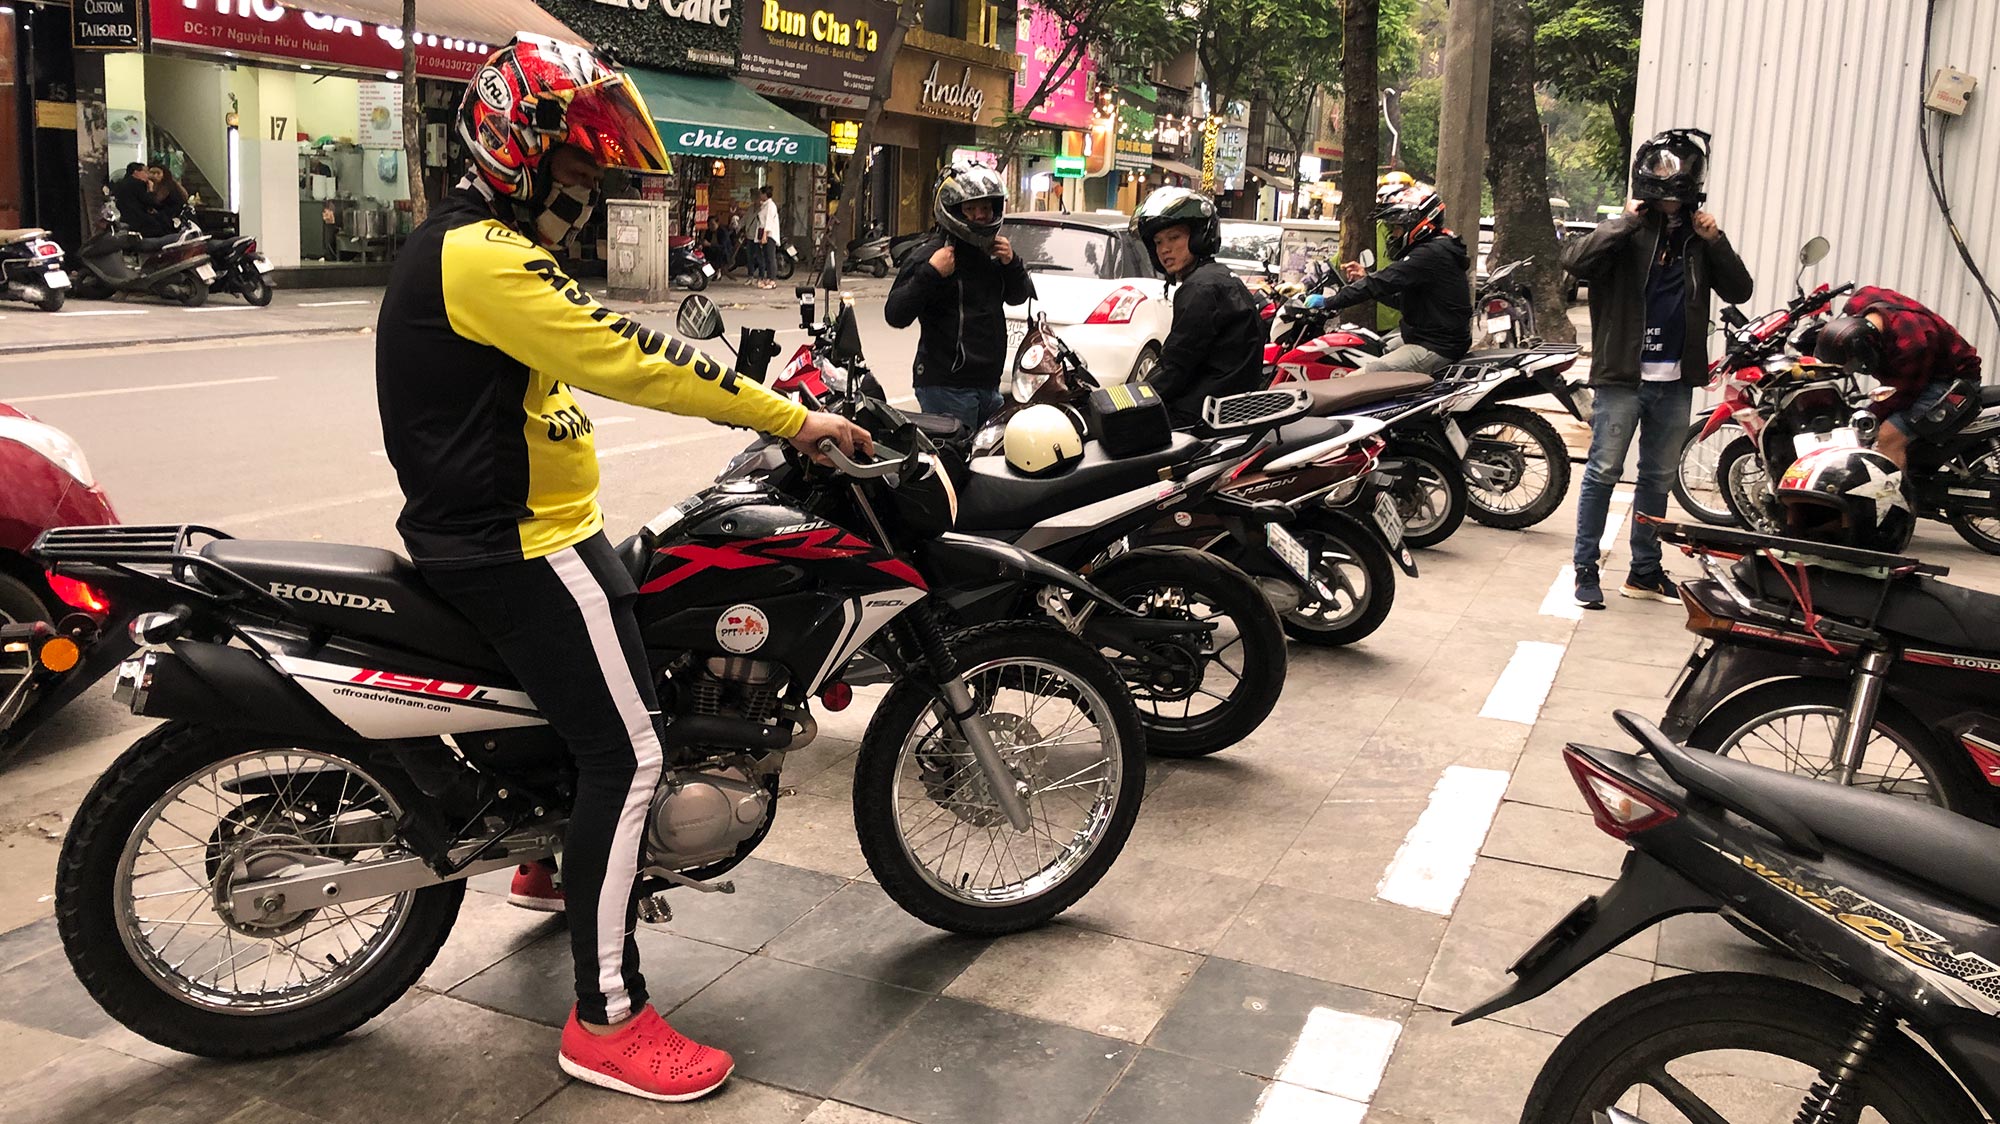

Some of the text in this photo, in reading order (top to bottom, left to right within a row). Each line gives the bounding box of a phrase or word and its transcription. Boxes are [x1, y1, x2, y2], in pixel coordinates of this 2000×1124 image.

[79, 22, 132, 38] TAILORED
[211, 26, 223, 38] 17
[761, 0, 878, 52] Bun Cha Ta
[923, 60, 986, 123] Analog
[270, 116, 288, 141] 17
[1222, 131, 1240, 144] THE
[679, 129, 798, 156] chie cafe
[773, 521, 830, 536] 150L
[269, 582, 396, 614] HONDA
[865, 599, 907, 608] 150L
[333, 687, 451, 714] offroadvietnam.com
